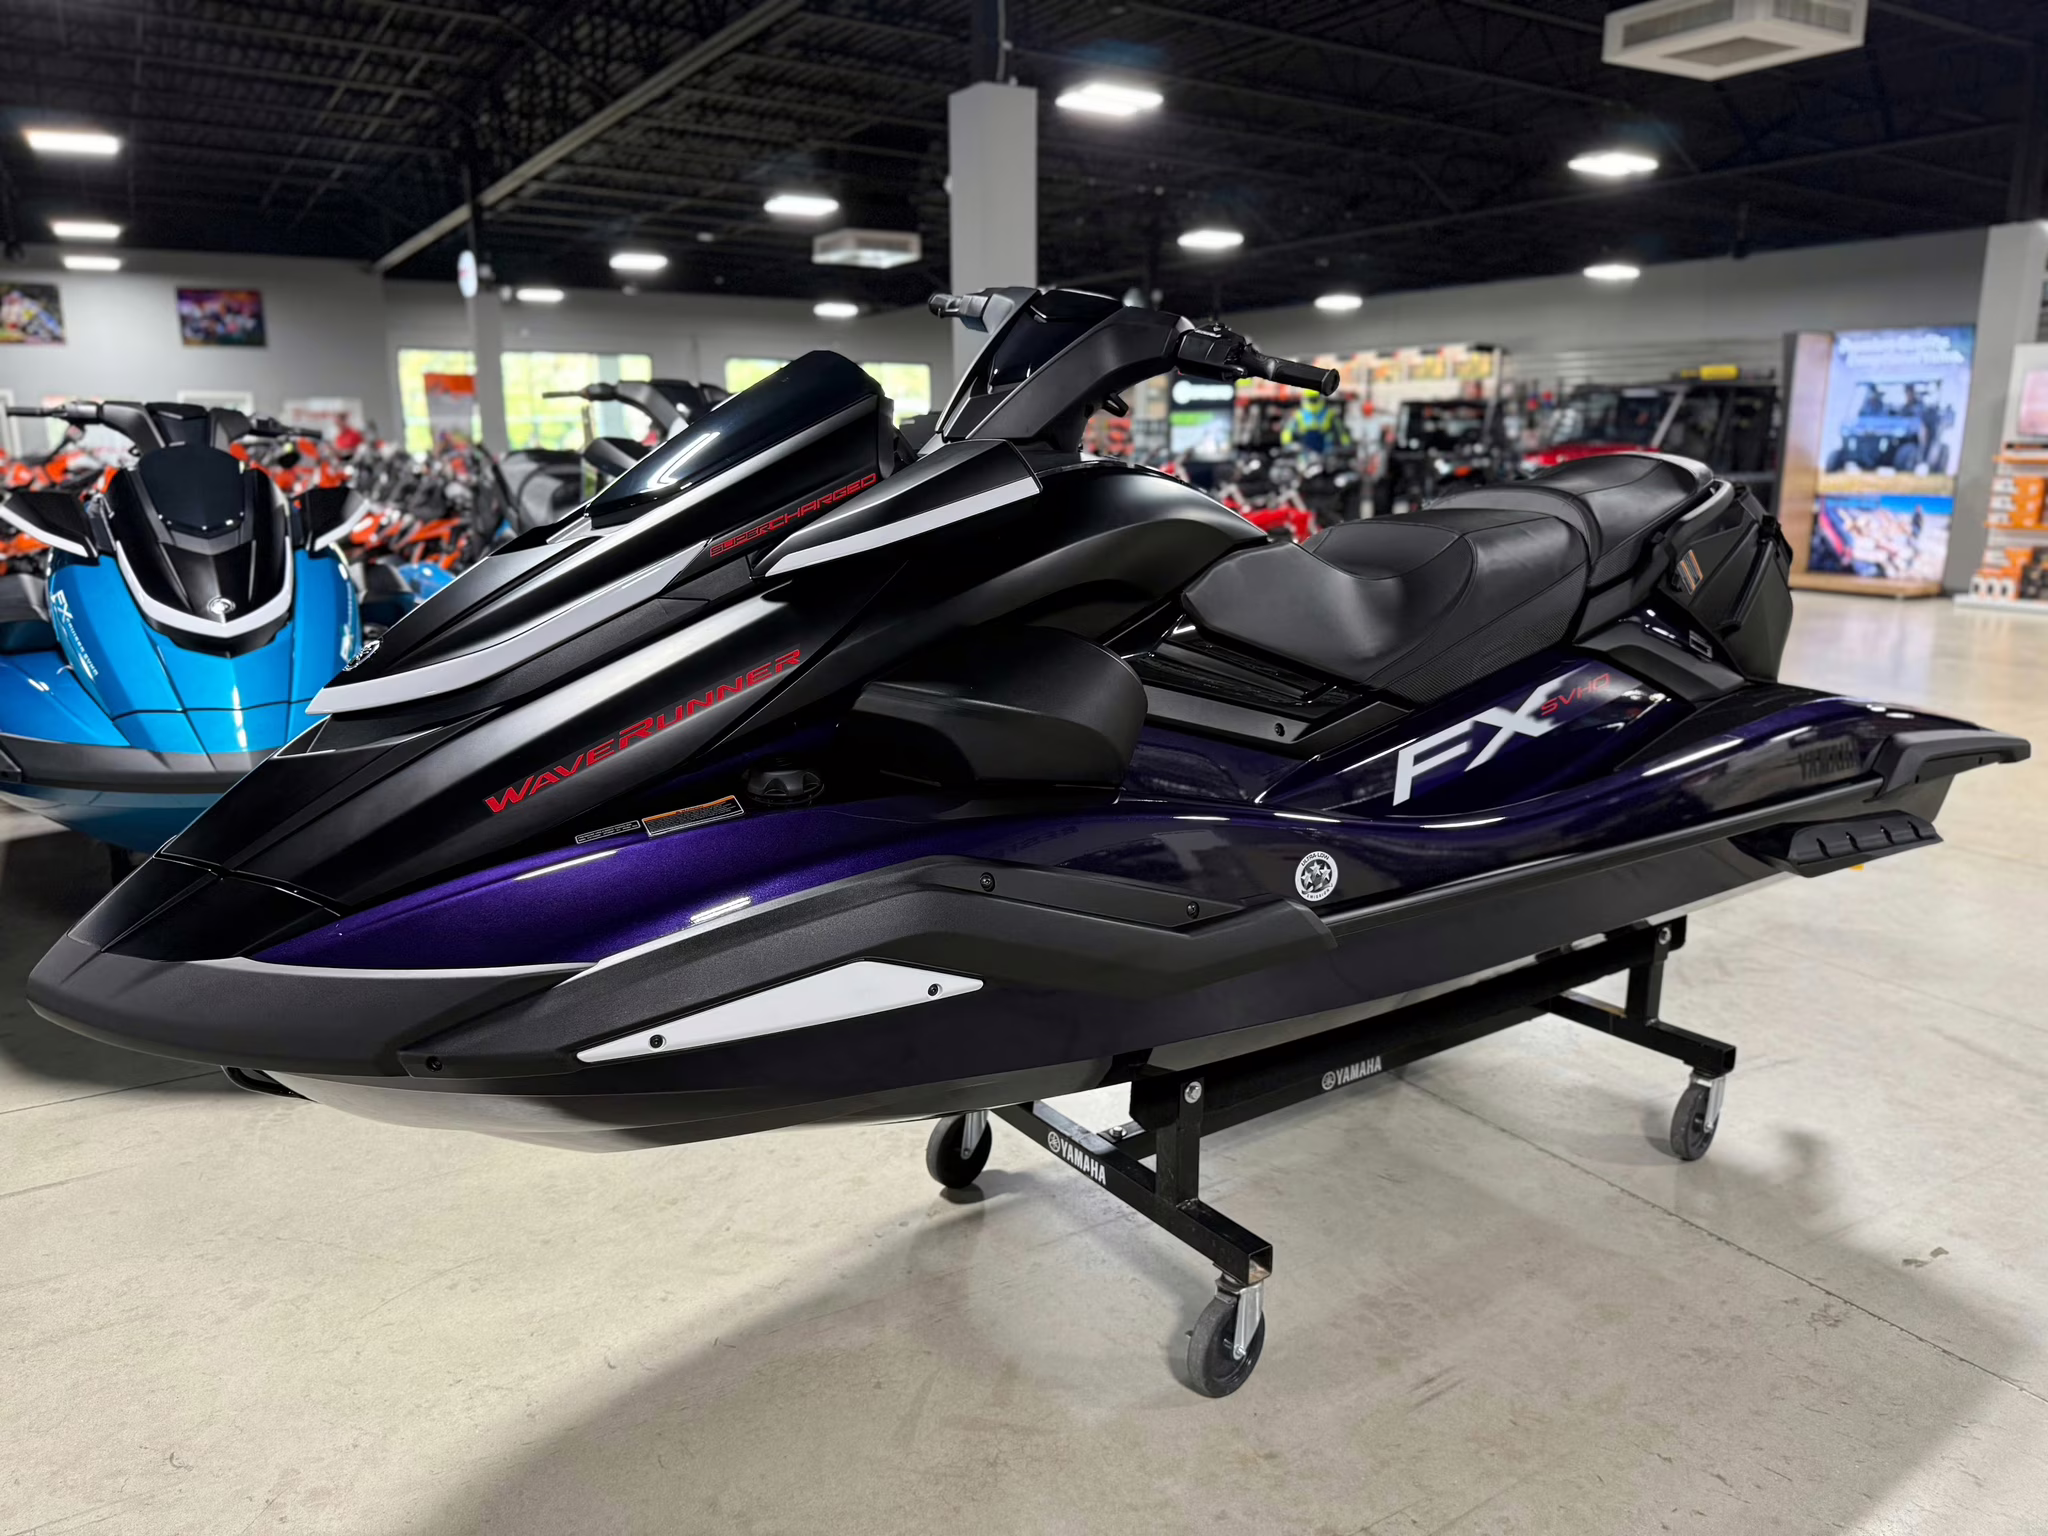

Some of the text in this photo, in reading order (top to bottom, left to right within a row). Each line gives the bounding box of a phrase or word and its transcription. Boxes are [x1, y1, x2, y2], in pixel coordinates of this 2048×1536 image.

[710, 473, 877, 558] SUPERCHARGED
[484, 649, 801, 813] WAVERUNNER
[1392, 663, 1611, 807] FX SVHO
[1336, 1055, 1382, 1086] YAMAHA
[1060, 1138, 1107, 1186] YAMAHA
